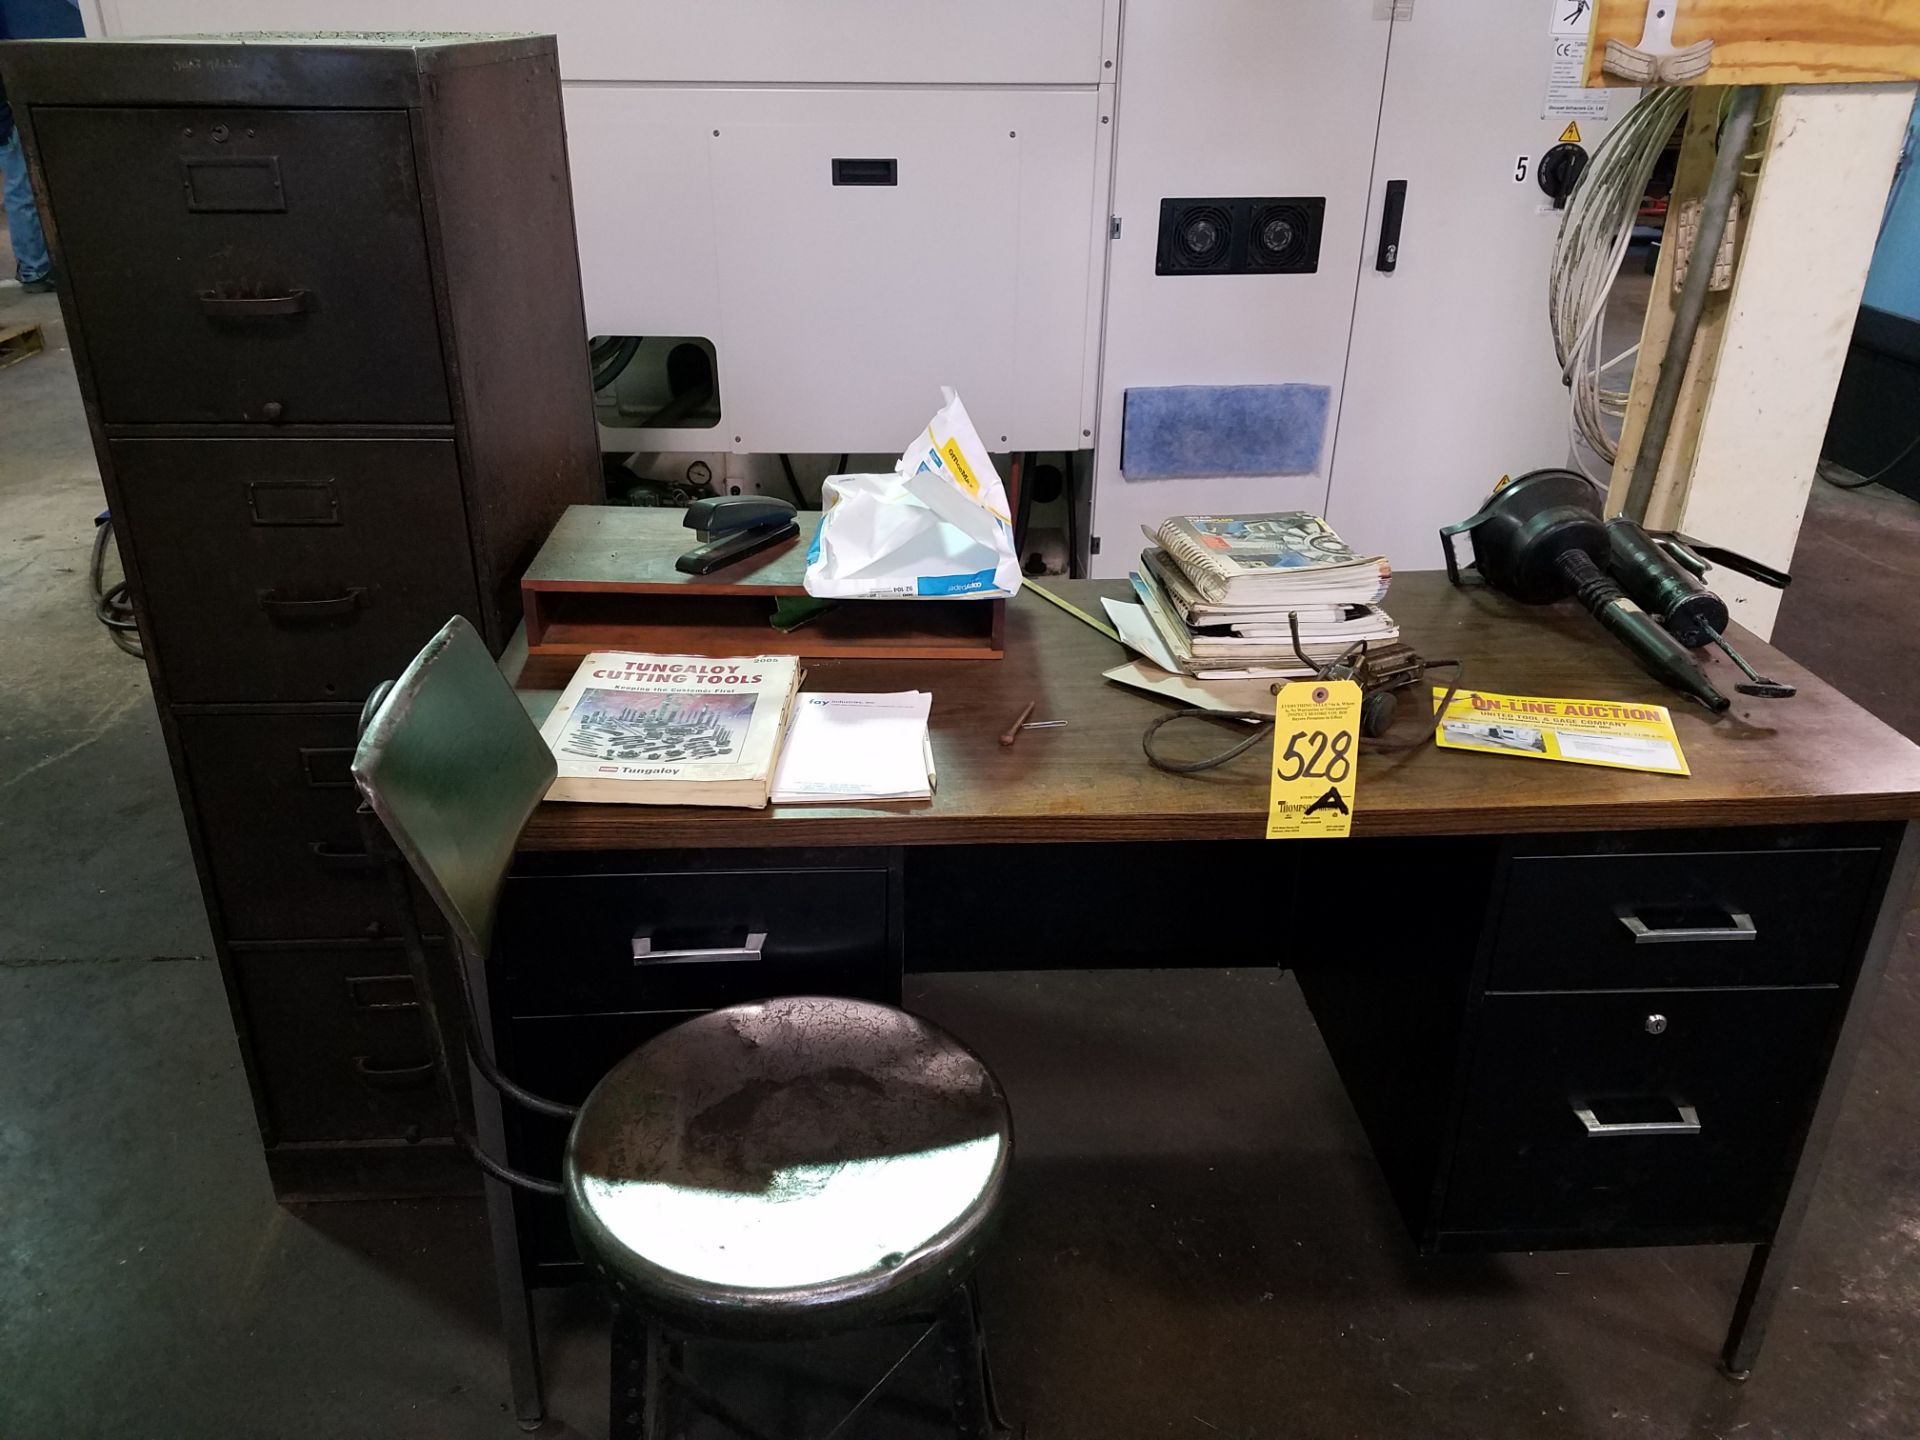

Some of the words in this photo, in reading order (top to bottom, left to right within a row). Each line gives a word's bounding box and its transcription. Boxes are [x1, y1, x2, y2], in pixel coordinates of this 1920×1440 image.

[1515, 157, 1528, 181] 5
[592, 670, 688, 684] CUTTING
[696, 674, 763, 684] TOOLS
[625, 662, 740, 674] TUNGALOY
[1471, 698, 1558, 715] ON-LINE
[1564, 705, 1662, 722] AUCTION
[1278, 730, 1352, 782] 528
[1304, 786, 1349, 816] A
